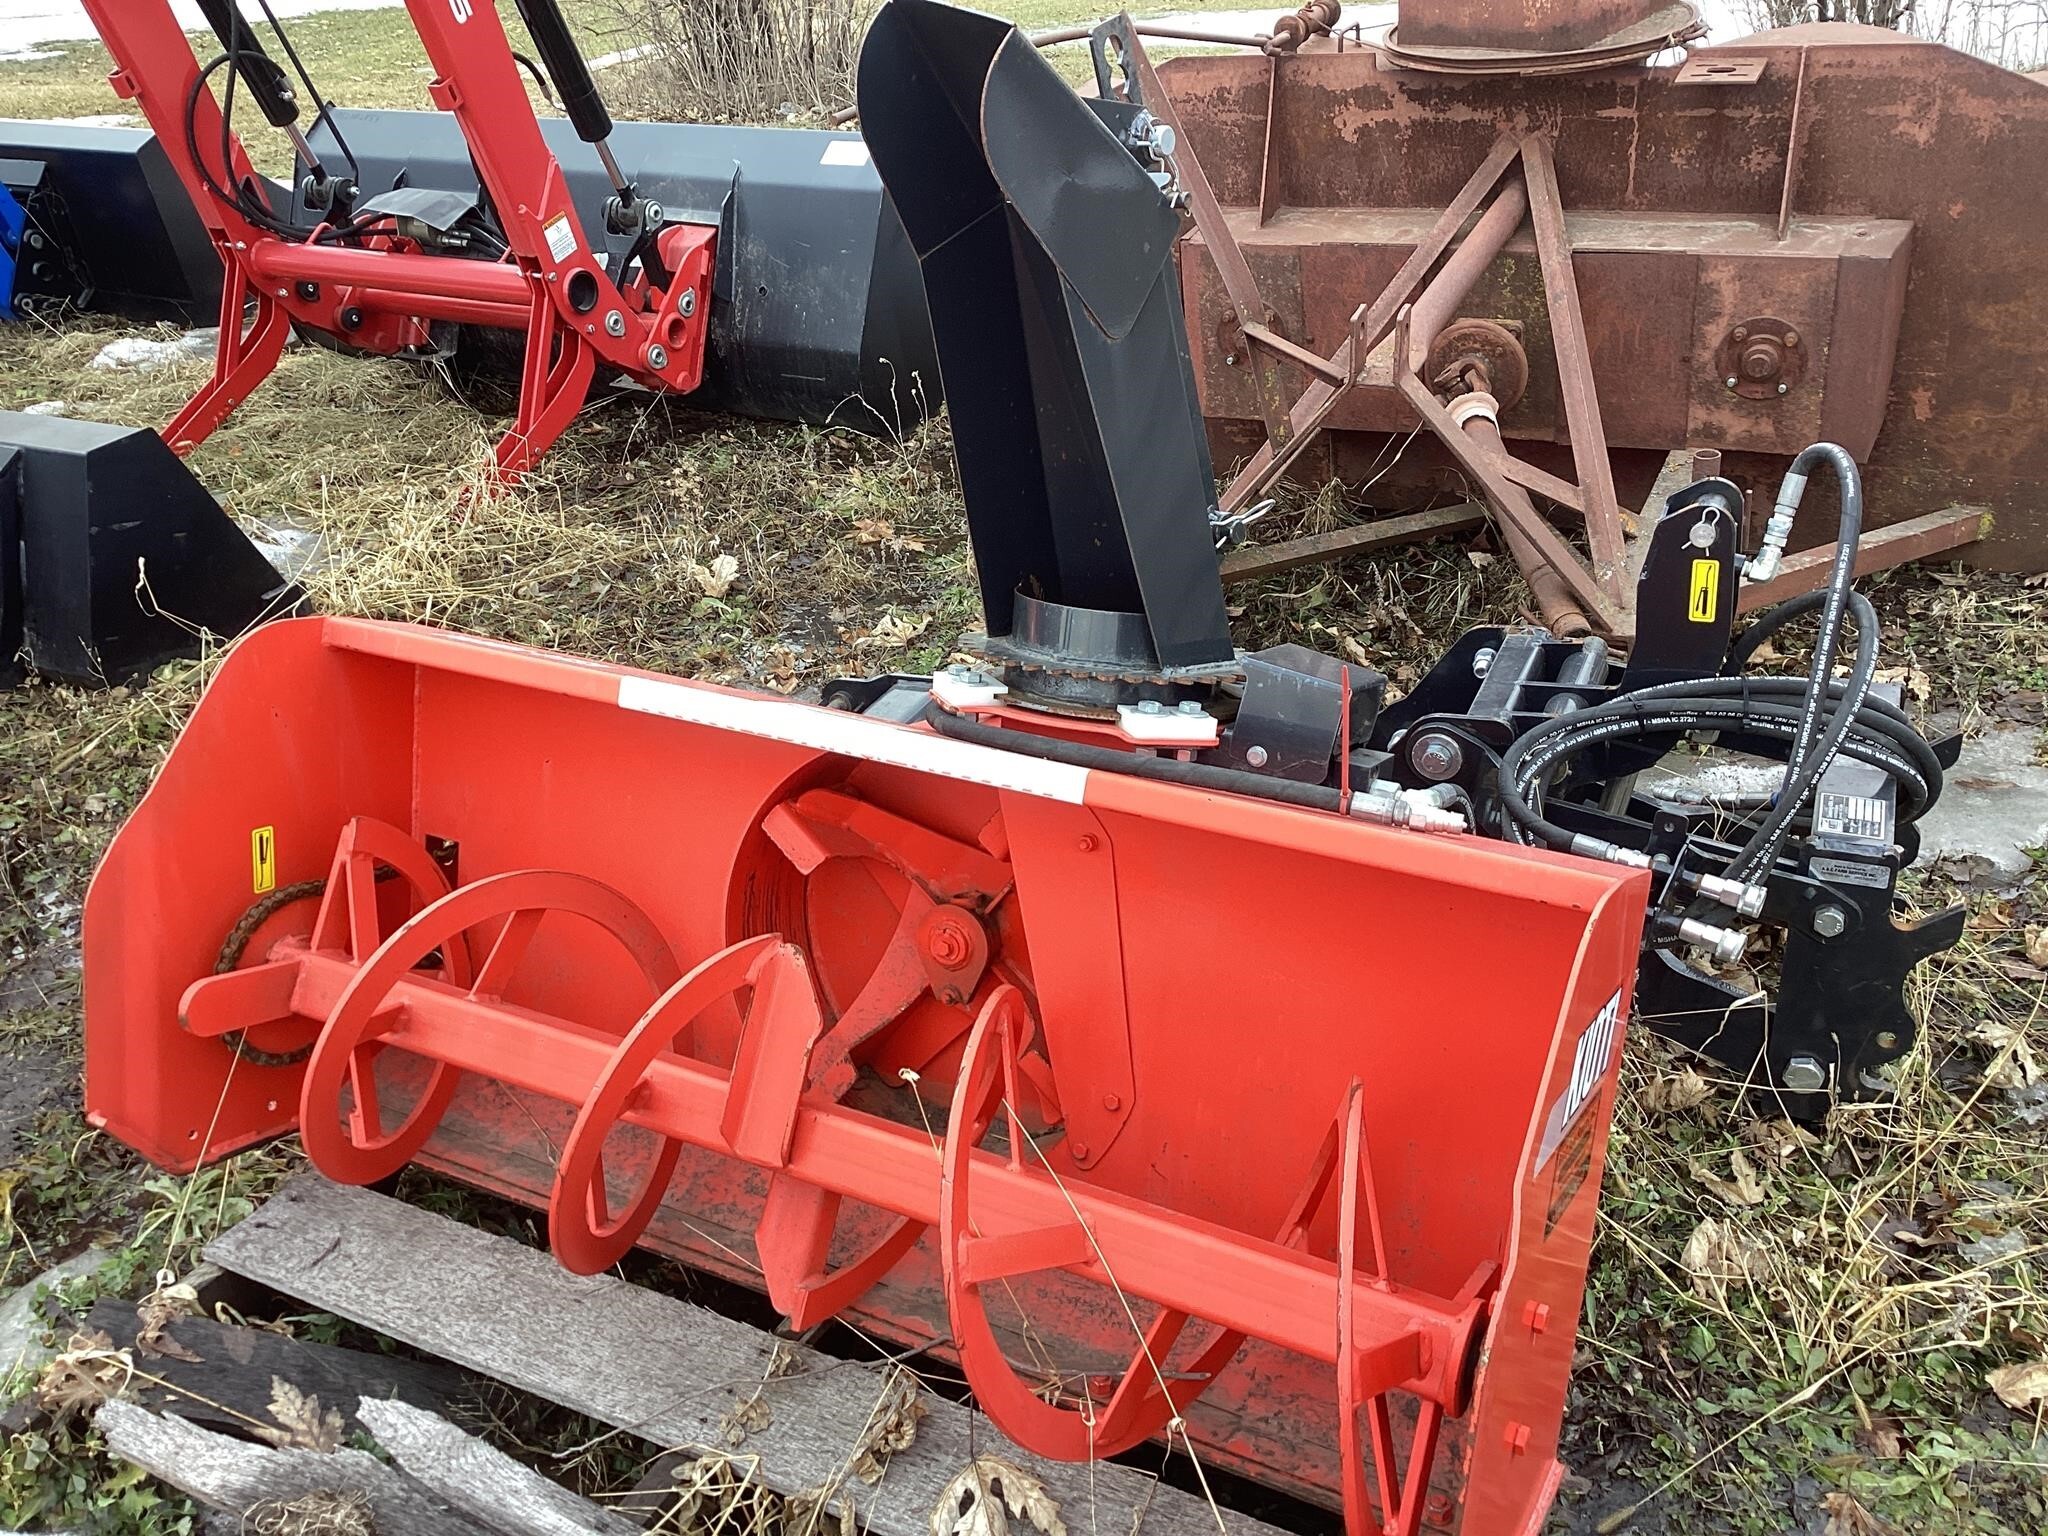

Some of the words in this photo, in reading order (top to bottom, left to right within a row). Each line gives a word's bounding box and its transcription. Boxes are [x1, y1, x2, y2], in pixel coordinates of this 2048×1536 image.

[1607, 724, 1619, 732] PSI
[1796, 748, 1806, 762] SAE
[1818, 654, 1827, 670] BAR
[1826, 623, 1834, 634] PSI
[1834, 569, 1846, 589] MSHA
[1770, 829, 1781, 840] SAE
[1811, 773, 1820, 785] WP
[1825, 746, 1838, 761] BAR
[1845, 714, 1855, 727] PSI
